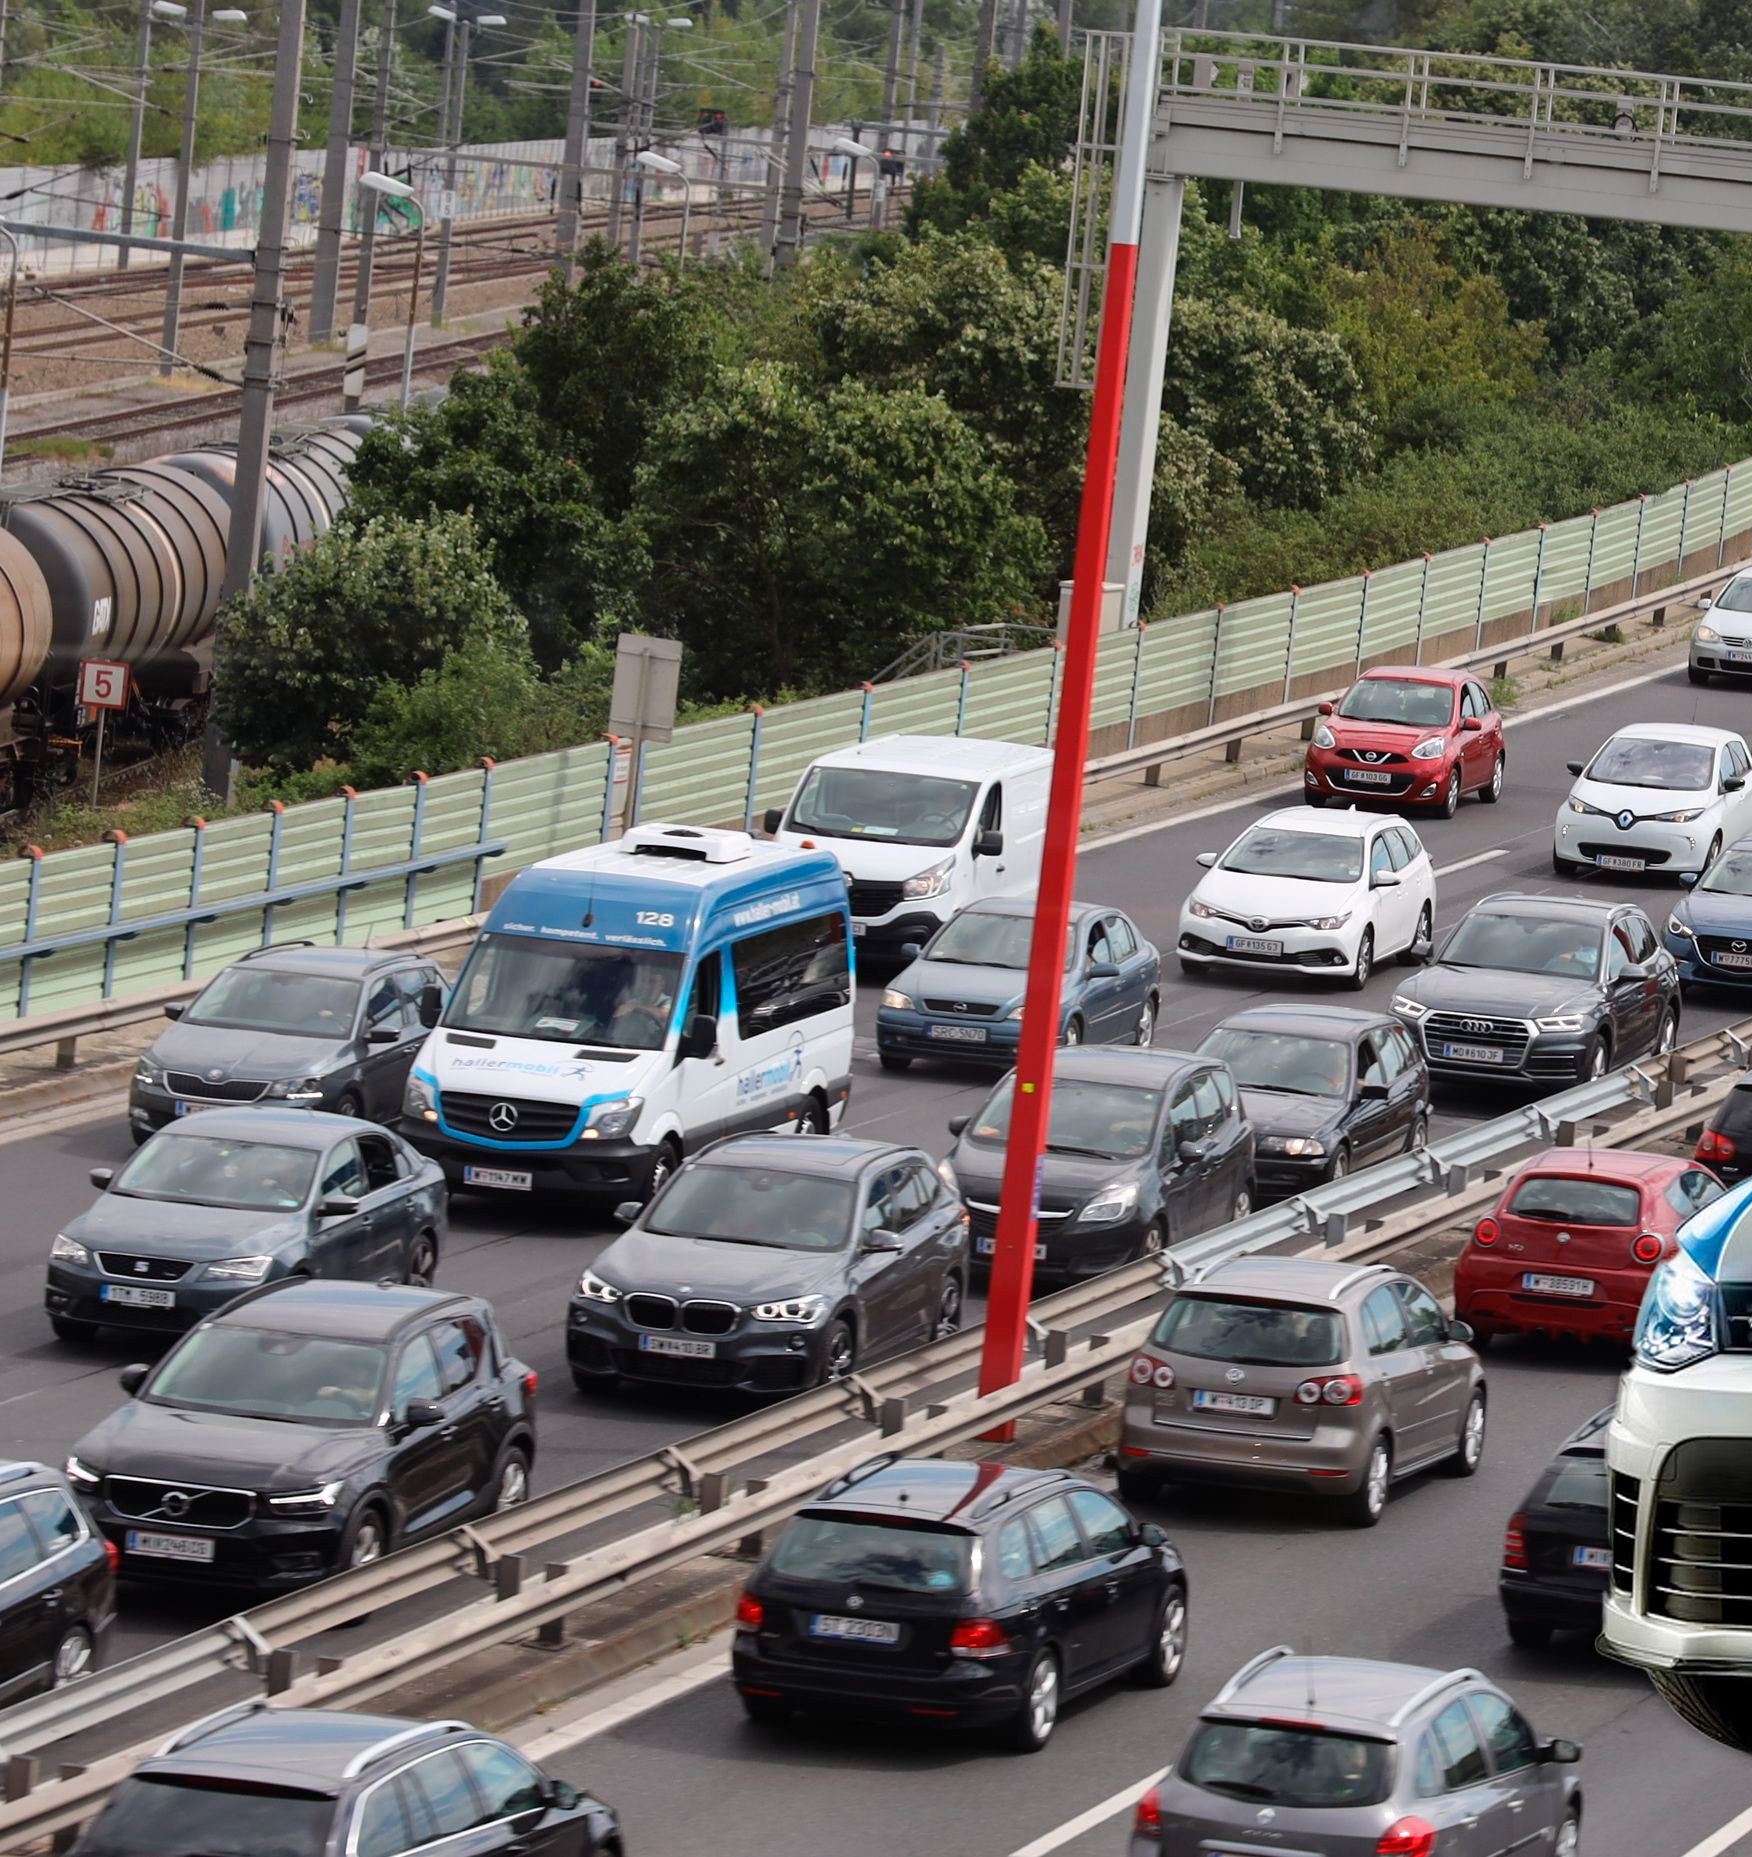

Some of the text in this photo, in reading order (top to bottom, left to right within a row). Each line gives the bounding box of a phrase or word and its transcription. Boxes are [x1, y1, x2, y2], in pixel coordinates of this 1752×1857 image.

[95, 669, 113, 698] 5
[636, 911, 674, 927] 128
[451, 1057, 560, 1075] hallermobil
